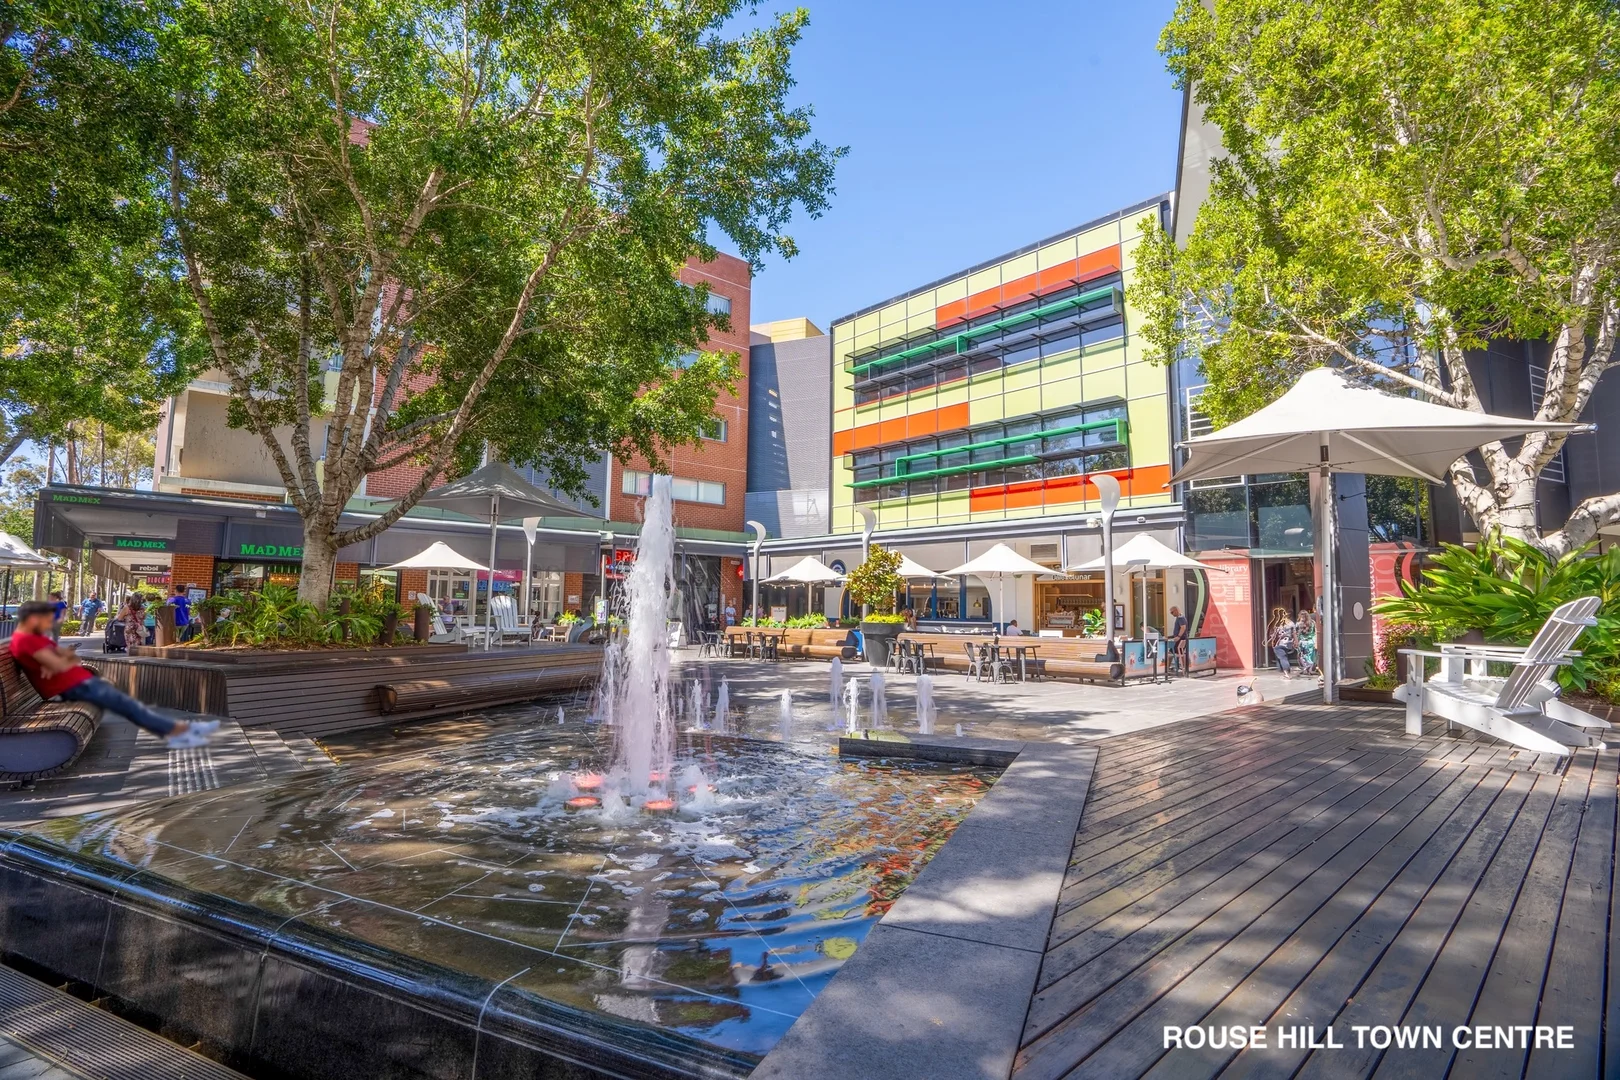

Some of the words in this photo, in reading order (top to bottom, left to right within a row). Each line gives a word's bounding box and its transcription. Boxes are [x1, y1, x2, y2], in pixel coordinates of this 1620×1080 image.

[116, 539, 142, 548] MAD
[142, 541, 167, 549] MEX
[240, 543, 277, 556] MAD
